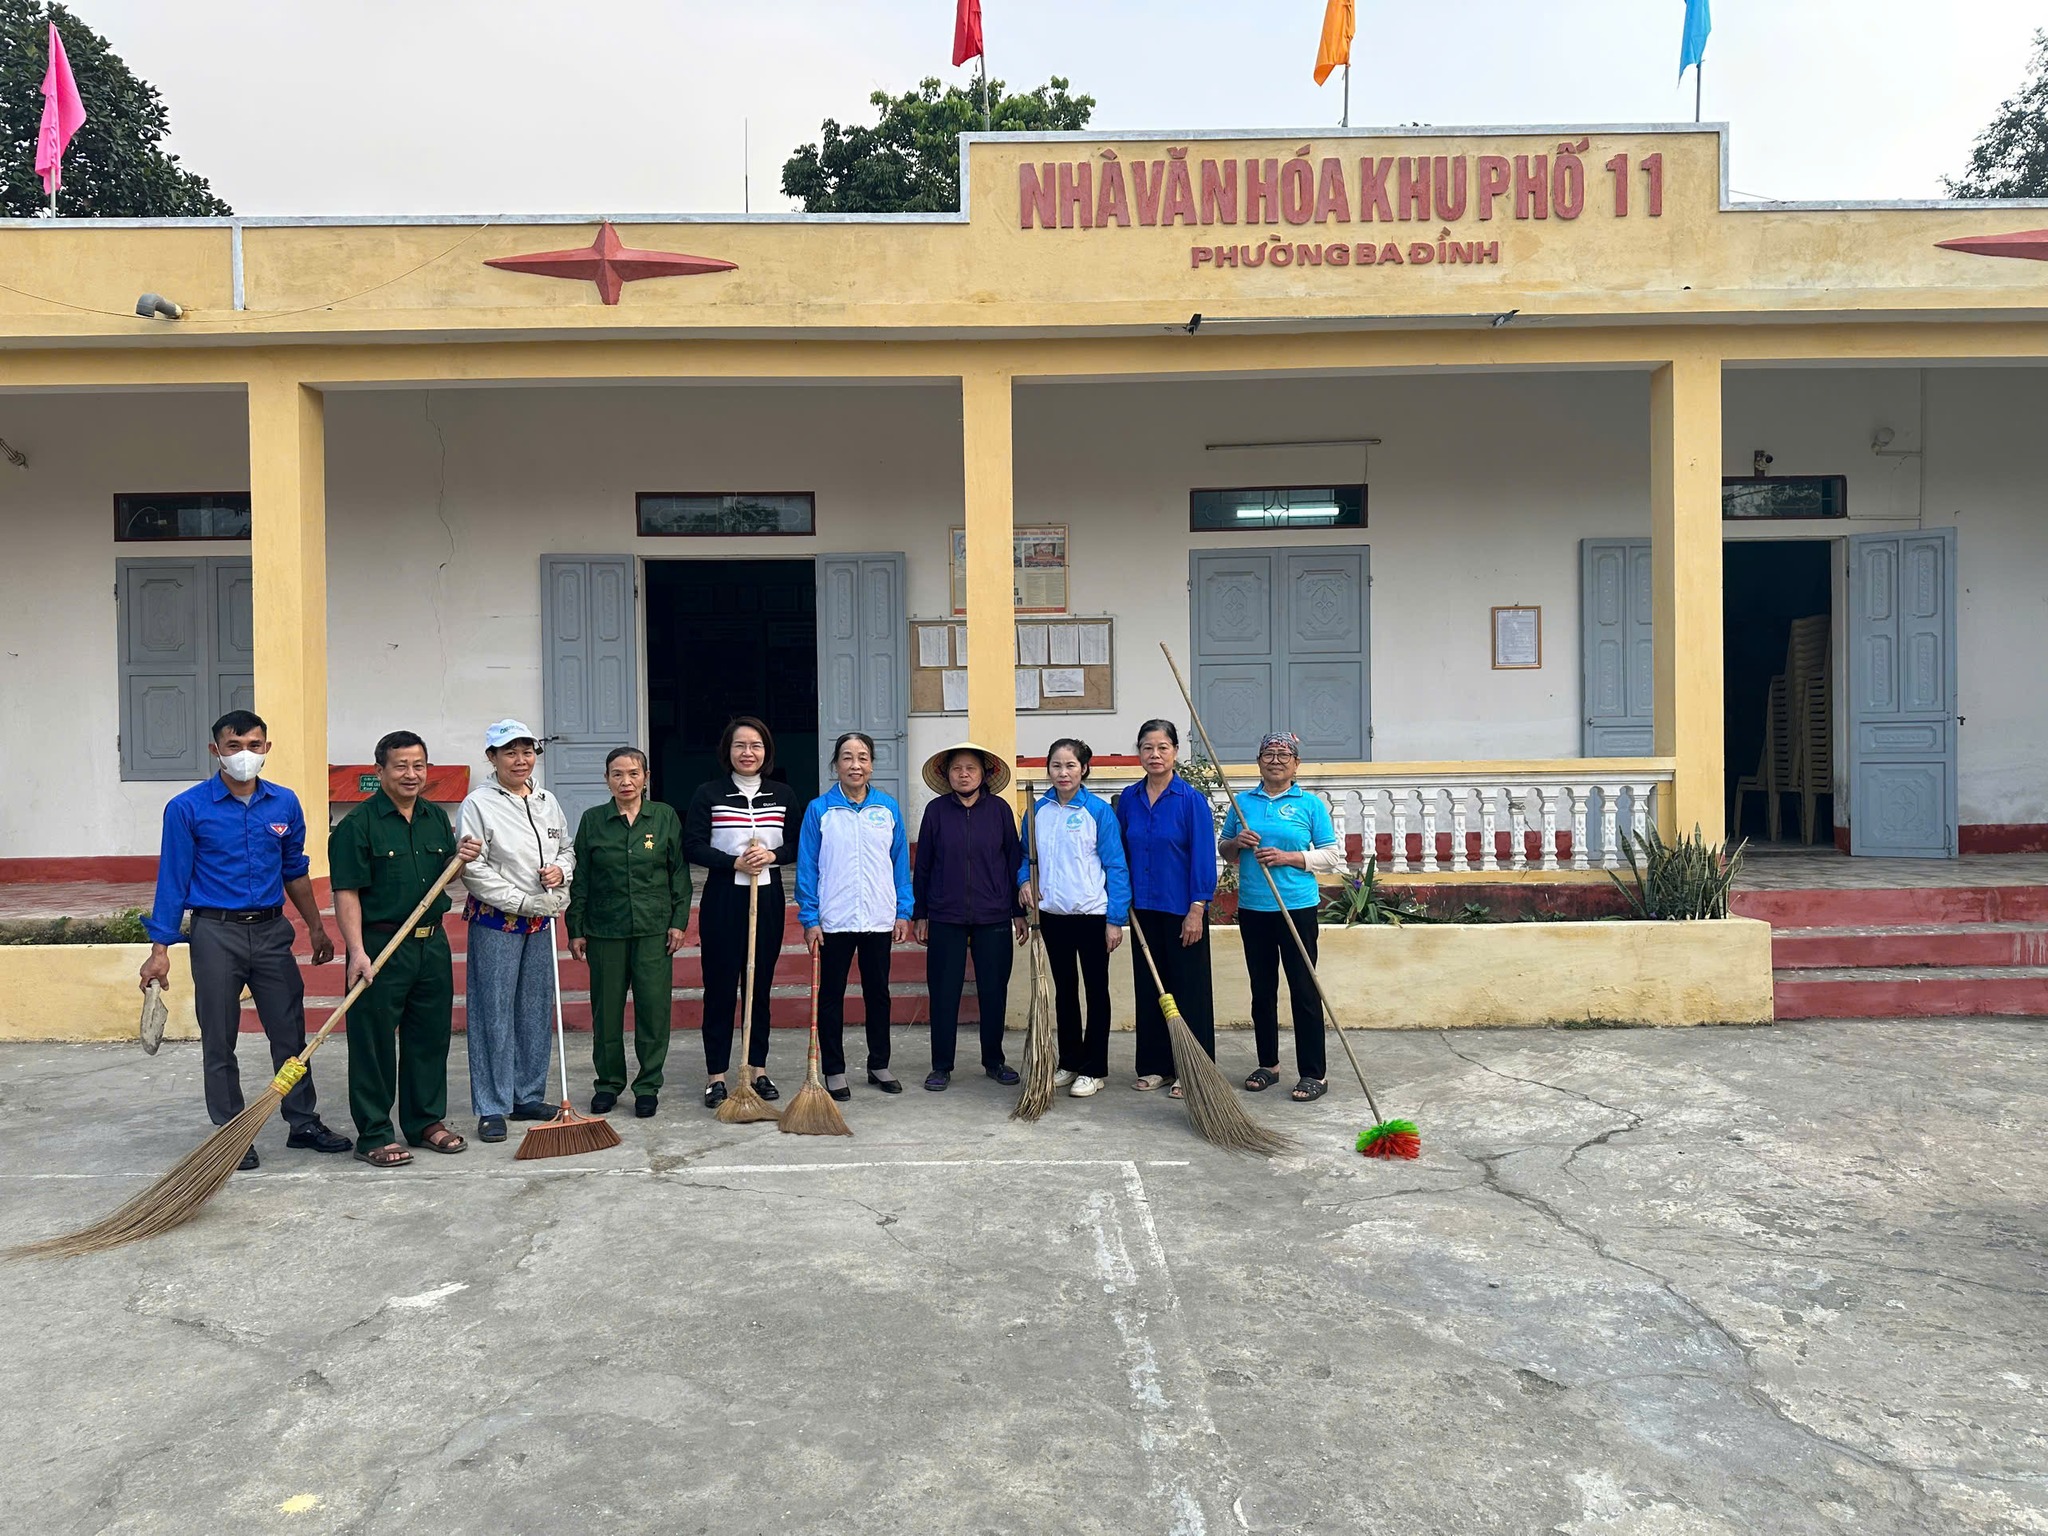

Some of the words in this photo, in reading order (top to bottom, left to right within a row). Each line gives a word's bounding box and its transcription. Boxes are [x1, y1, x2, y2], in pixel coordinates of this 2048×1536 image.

[1019, 148, 1131, 229] NHÀ
[1131, 146, 1238, 226] VĂN
[1246, 143, 1351, 224] HÓA
[1360, 154, 1467, 222] KHU
[1479, 136, 1590, 221] PHỐ
[1605, 152, 1662, 218] 11
[1191, 234, 1350, 268] PHƯỜNG
[1356, 242, 1404, 265] BA
